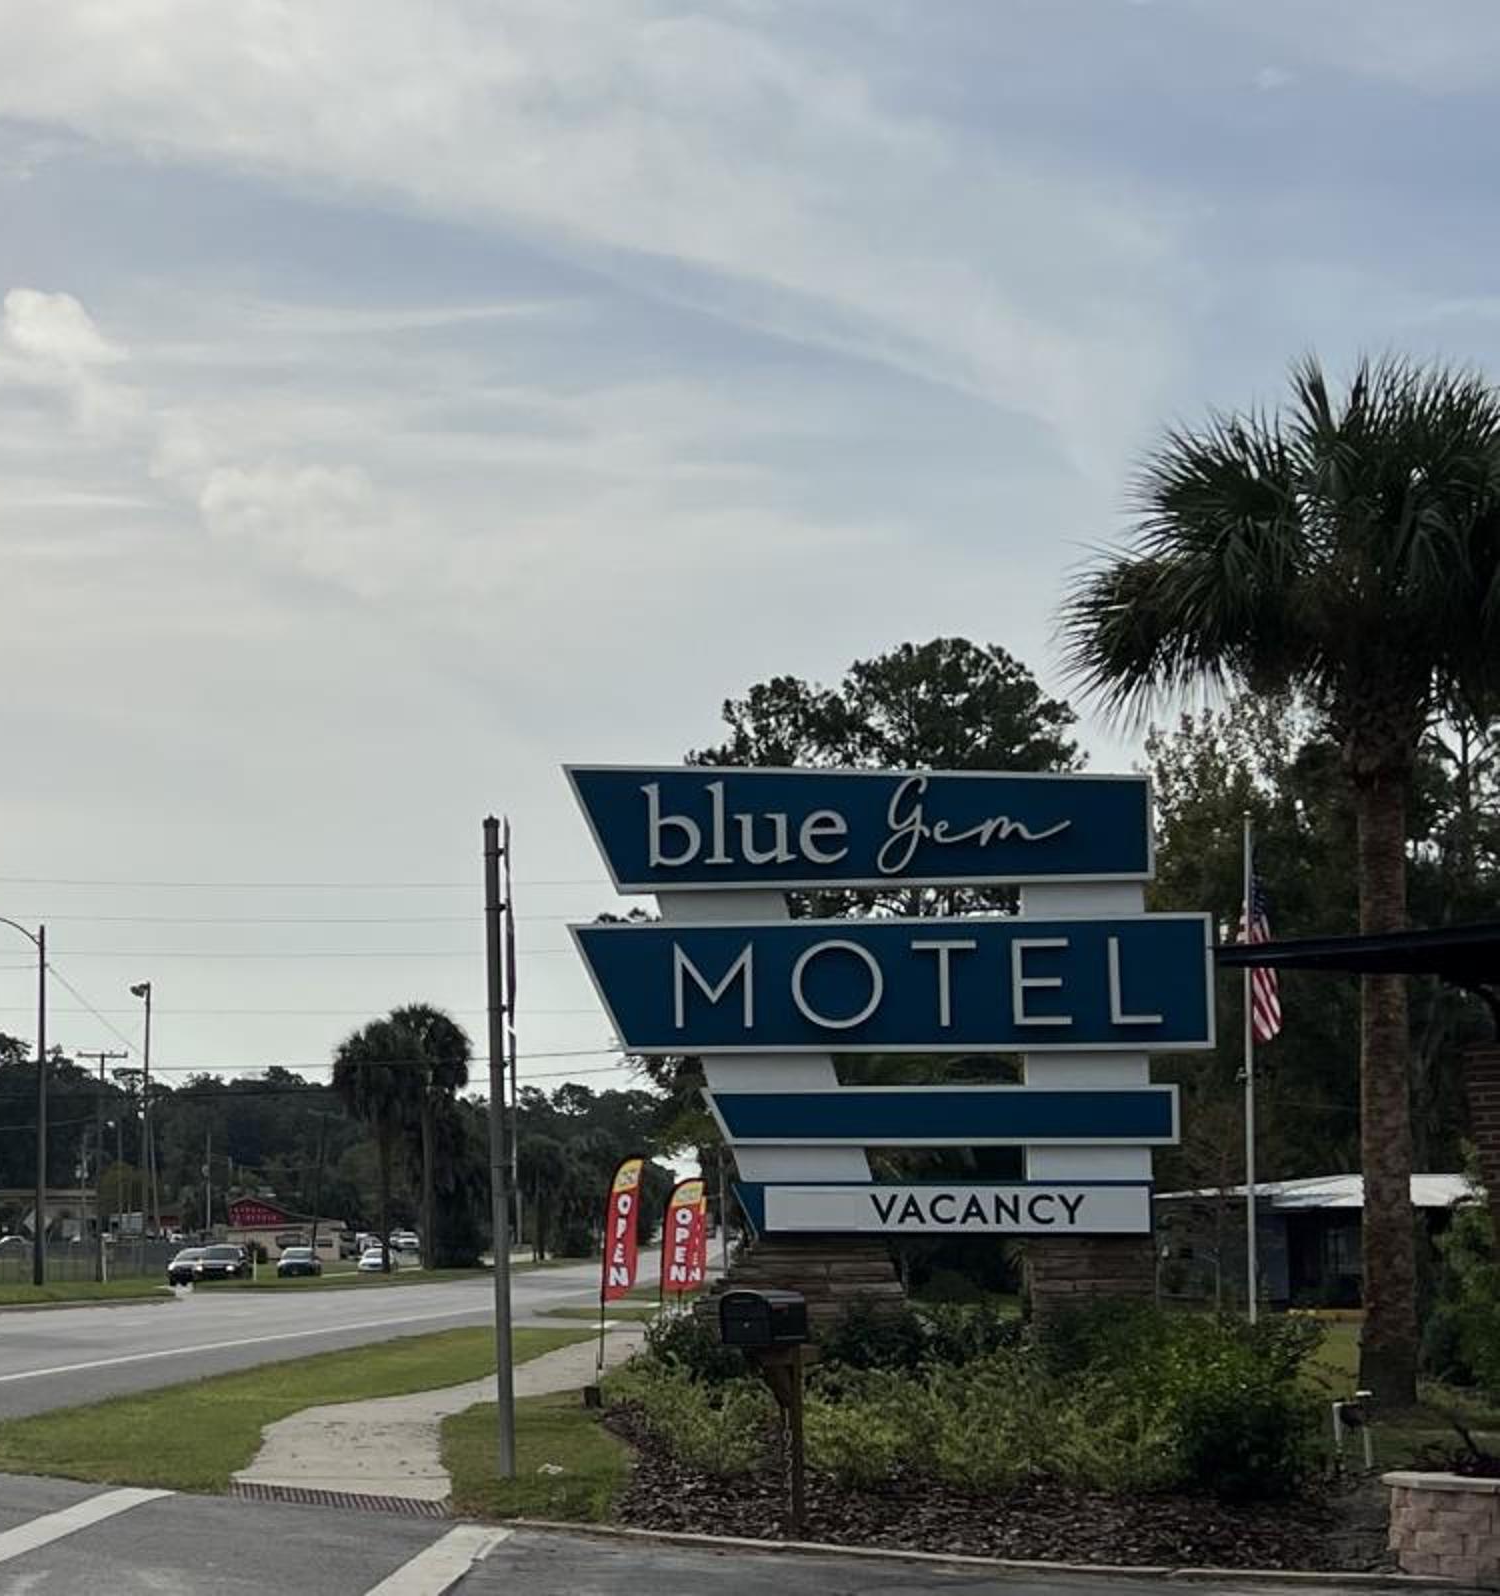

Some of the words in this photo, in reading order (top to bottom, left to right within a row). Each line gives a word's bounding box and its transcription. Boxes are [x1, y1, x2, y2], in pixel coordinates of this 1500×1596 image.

[640, 781, 849, 868] blue
[877, 774, 1072, 873] Gem
[672, 936, 1164, 1029] MOTEL
[609, 1193, 633, 1287] OPEN
[669, 1207, 694, 1282] OPEN
[870, 1192, 1086, 1225] VACANCY
